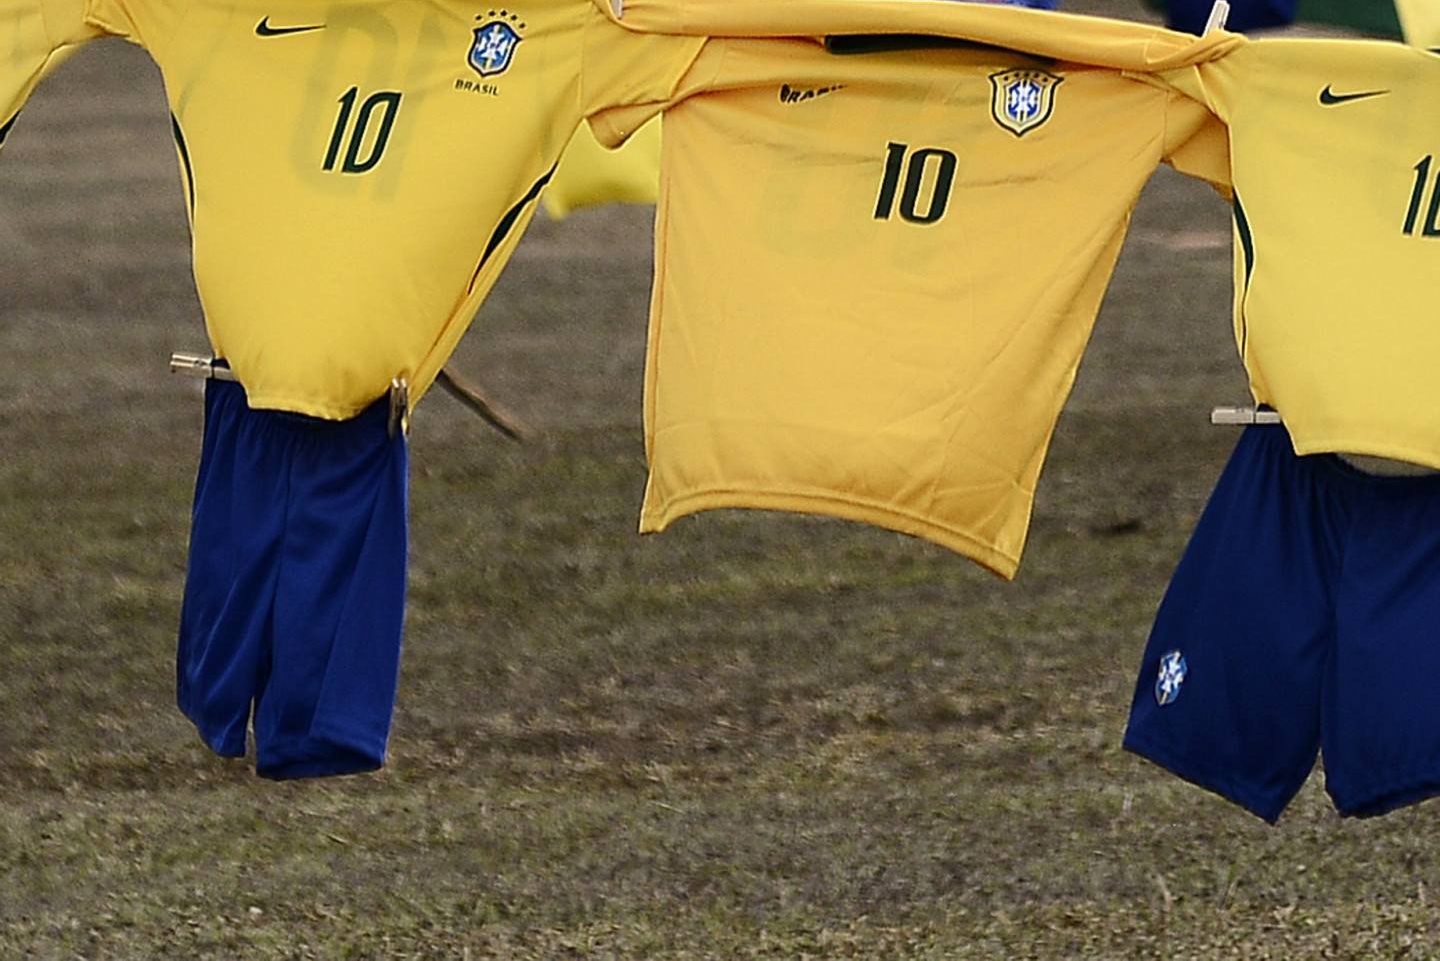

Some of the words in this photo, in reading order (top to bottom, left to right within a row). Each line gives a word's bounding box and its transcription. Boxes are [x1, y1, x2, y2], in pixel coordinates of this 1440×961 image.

[322, 85, 403, 174] 10
[455, 79, 499, 96] BRASIL
[874, 141, 957, 225] 10
